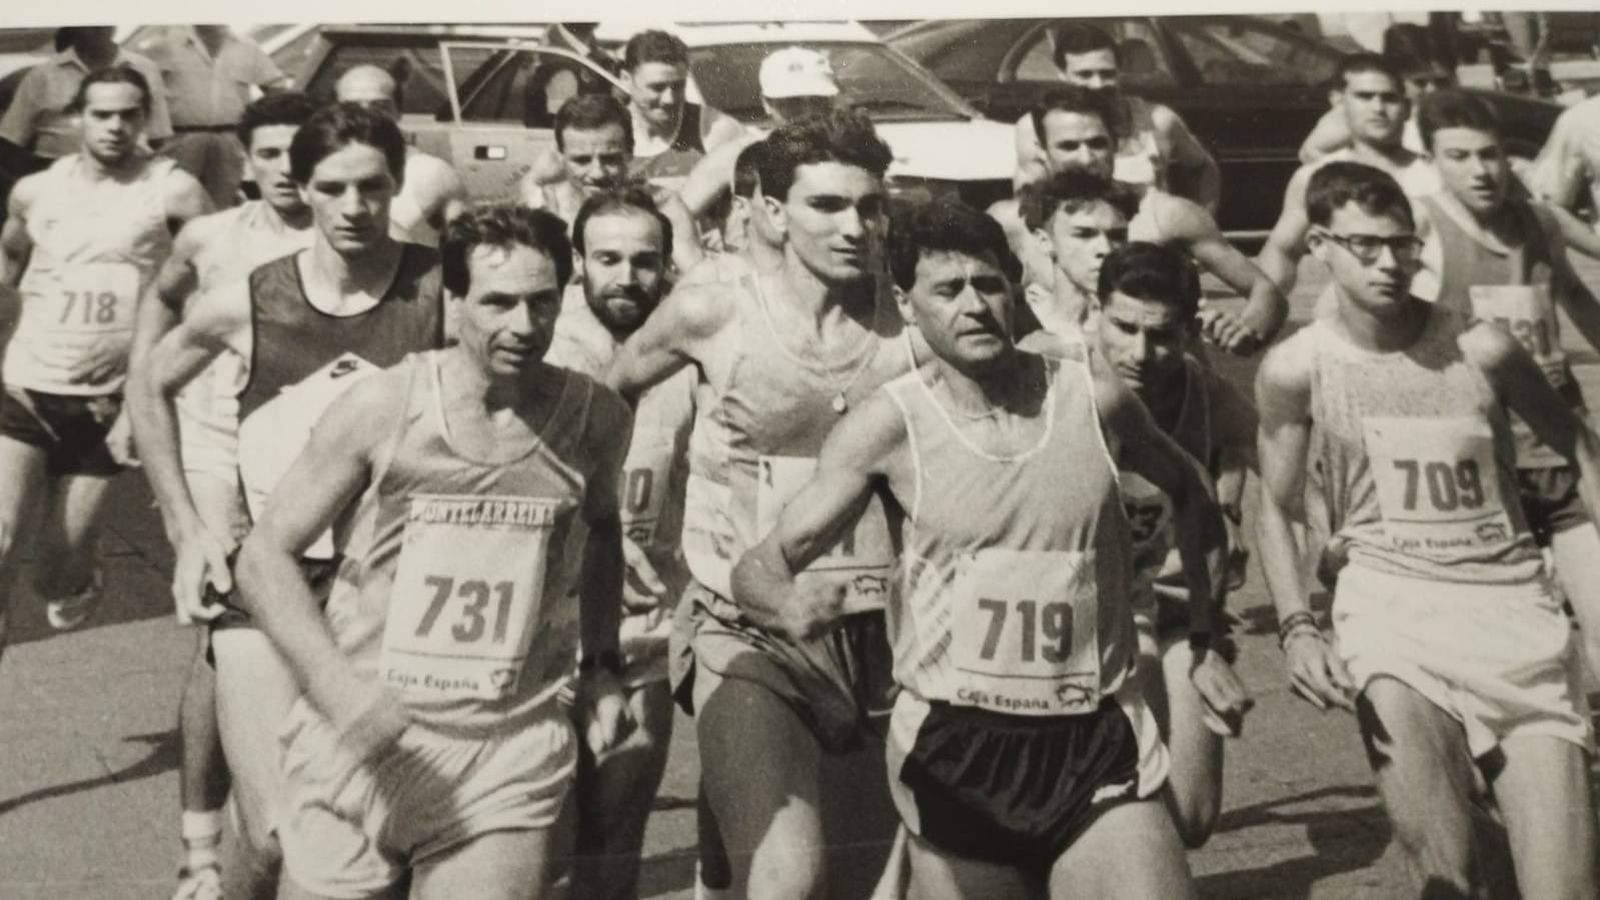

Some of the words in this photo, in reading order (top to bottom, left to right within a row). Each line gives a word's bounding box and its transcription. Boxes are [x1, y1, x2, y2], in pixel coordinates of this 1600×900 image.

[58, 290, 118, 325] 718
[1393, 458, 1485, 512] 709
[1392, 536, 1421, 550] Caja
[414, 574, 515, 645] 731
[978, 598, 1074, 664] 719
[386, 668, 418, 687] Caja
[423, 673, 480, 691] España
[956, 687, 990, 704] Caja
[994, 694, 1050, 710] España
